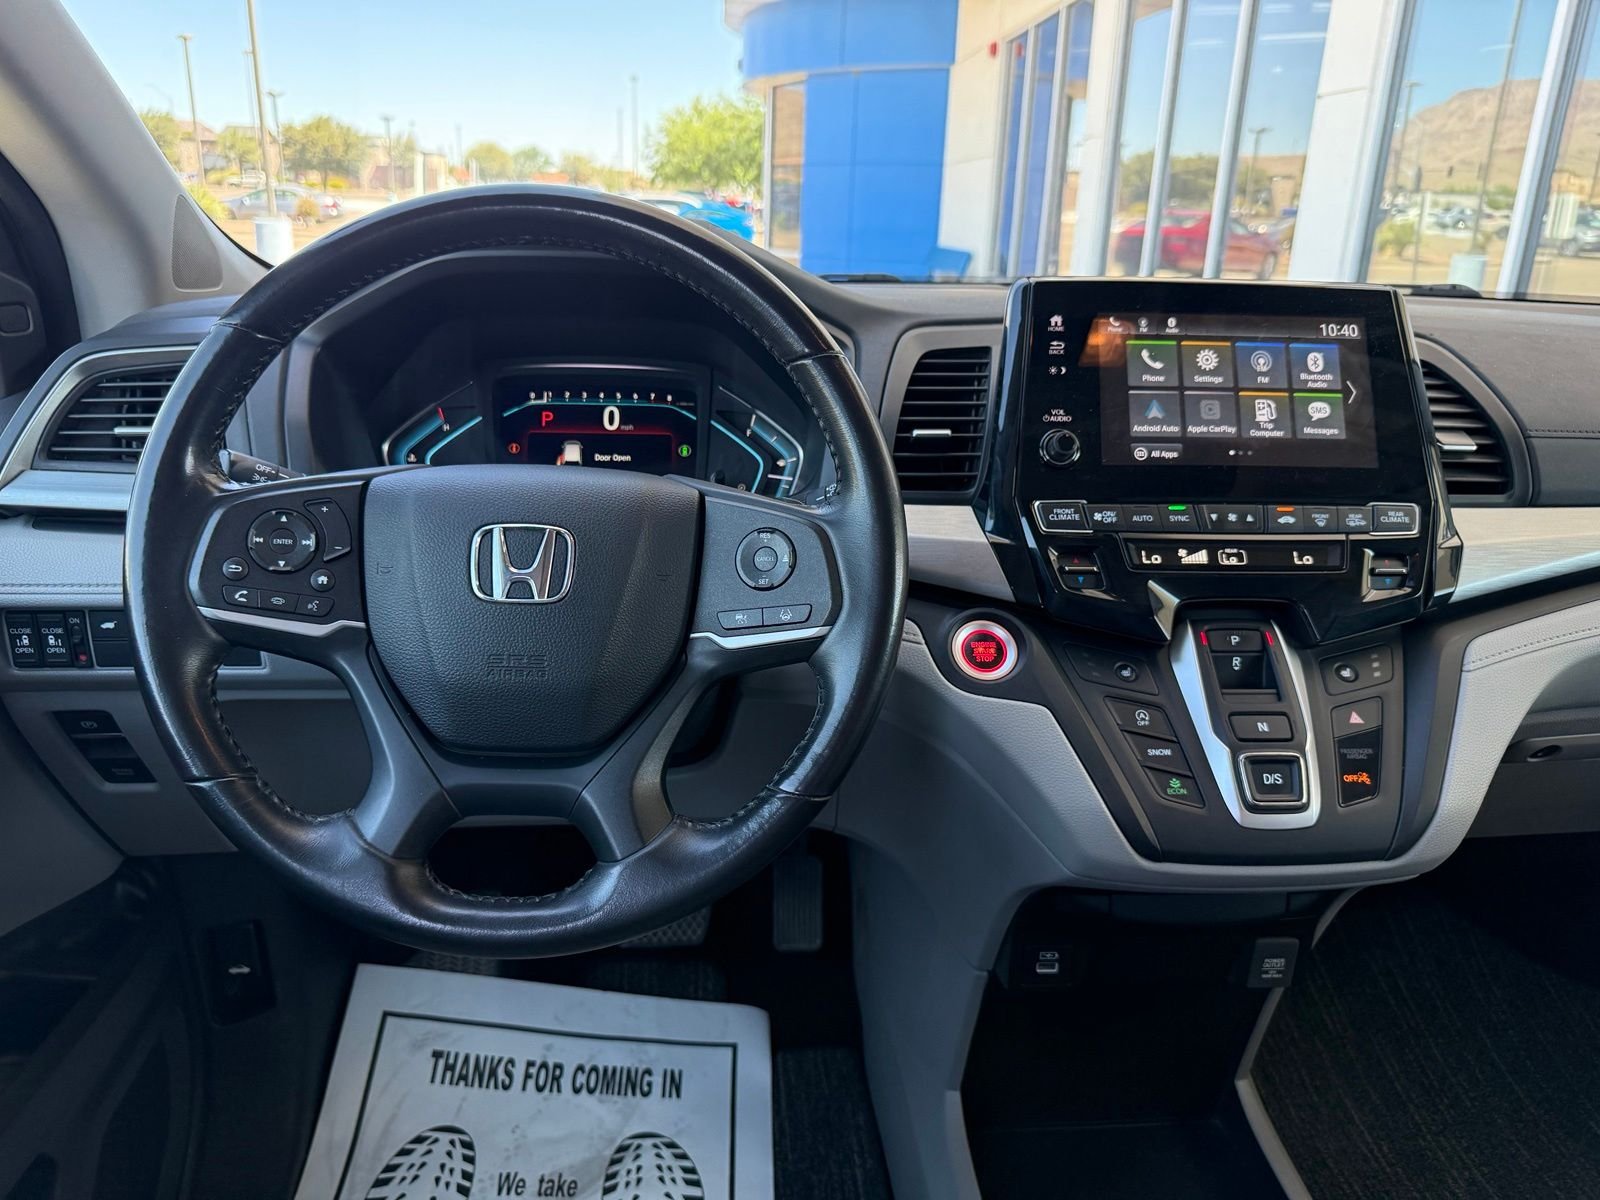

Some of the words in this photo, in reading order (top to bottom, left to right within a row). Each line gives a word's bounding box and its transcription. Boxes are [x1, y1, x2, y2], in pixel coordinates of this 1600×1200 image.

[1319, 323, 1358, 337] 10:40
[1194, 375, 1223, 384] Settings
[1299, 373, 1333, 381] Bluetooth
[1310, 406, 1328, 414] SMS
[541, 410, 554, 427] P
[602, 405, 620, 431] 0
[1132, 424, 1160, 432] Android
[1187, 425, 1208, 434] Apple
[1209, 425, 1237, 434] CarPlay
[1259, 421, 1274, 430] Trip
[1249, 429, 1284, 438] Computer
[1303, 427, 1339, 435] Messages
[594, 453, 611, 461] Door
[612, 453, 632, 463] Open
[1150, 450, 1161, 458] All
[1161, 451, 1179, 459] Apps
[255, 463, 272, 474] OFF
[1048, 513, 1080, 521] CLIMATE
[1140, 549, 1162, 564] Lo
[1293, 550, 1314, 565] Lo
[1230, 634, 1241, 646] P
[1231, 656, 1242, 667] R
[1256, 722, 1270, 732] N
[1147, 748, 1172, 756] SNOW
[1262, 773, 1284, 785] D/S
[1342, 774, 1358, 783] OFF
[1166, 787, 1187, 795] ECON
[430, 1048, 516, 1092] THANKS
[521, 1059, 565, 1094] FOR
[572, 1063, 653, 1098] COMING
[661, 1068, 683, 1100] IN
[497, 1171, 527, 1197] We
[536, 1171, 578, 1198] take
